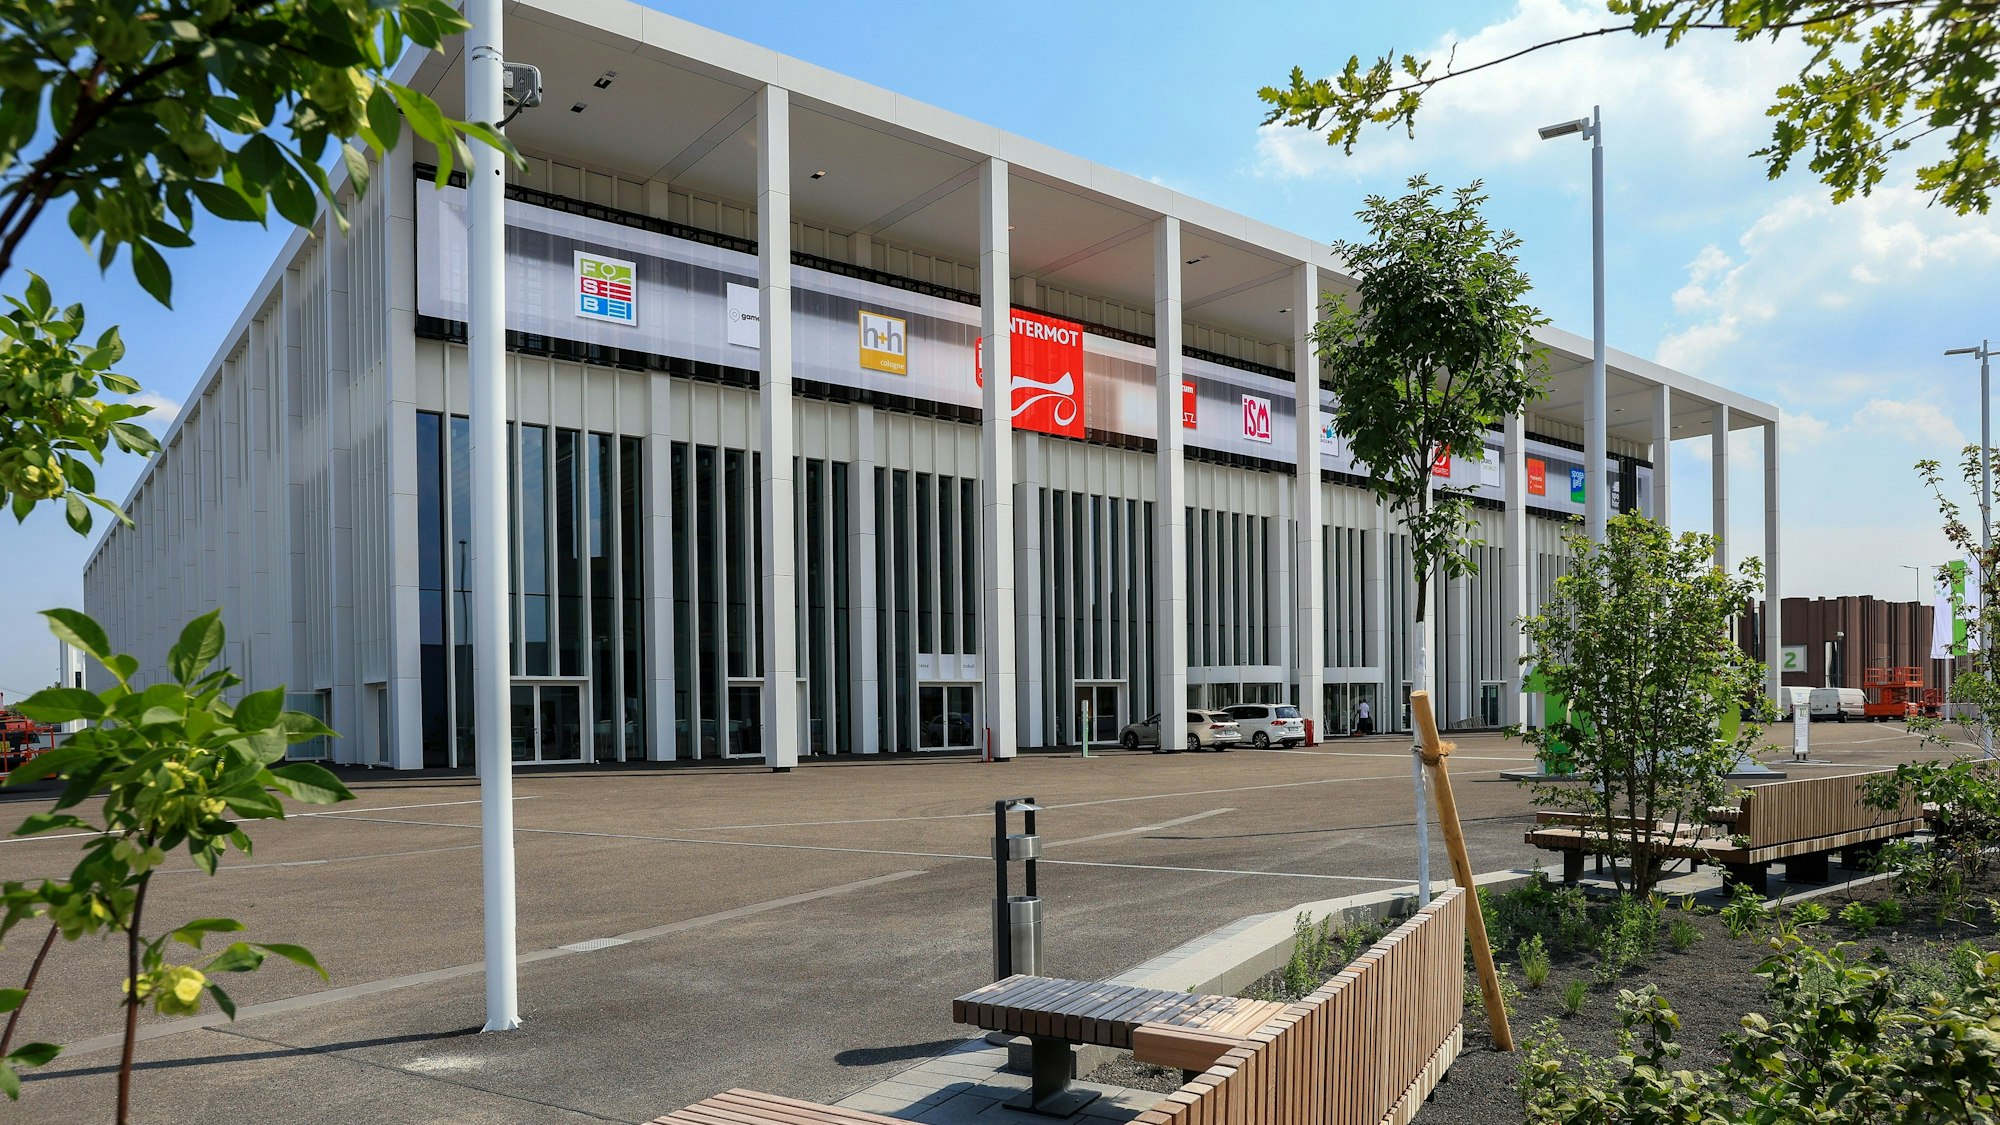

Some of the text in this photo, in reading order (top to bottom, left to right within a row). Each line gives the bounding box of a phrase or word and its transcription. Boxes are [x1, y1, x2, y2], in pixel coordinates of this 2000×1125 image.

[862, 315, 903, 354] h+h
[1010, 316, 1079, 347] NTERMOT
[880, 360, 905, 370] cologne
[1784, 652, 1797, 669] 2
